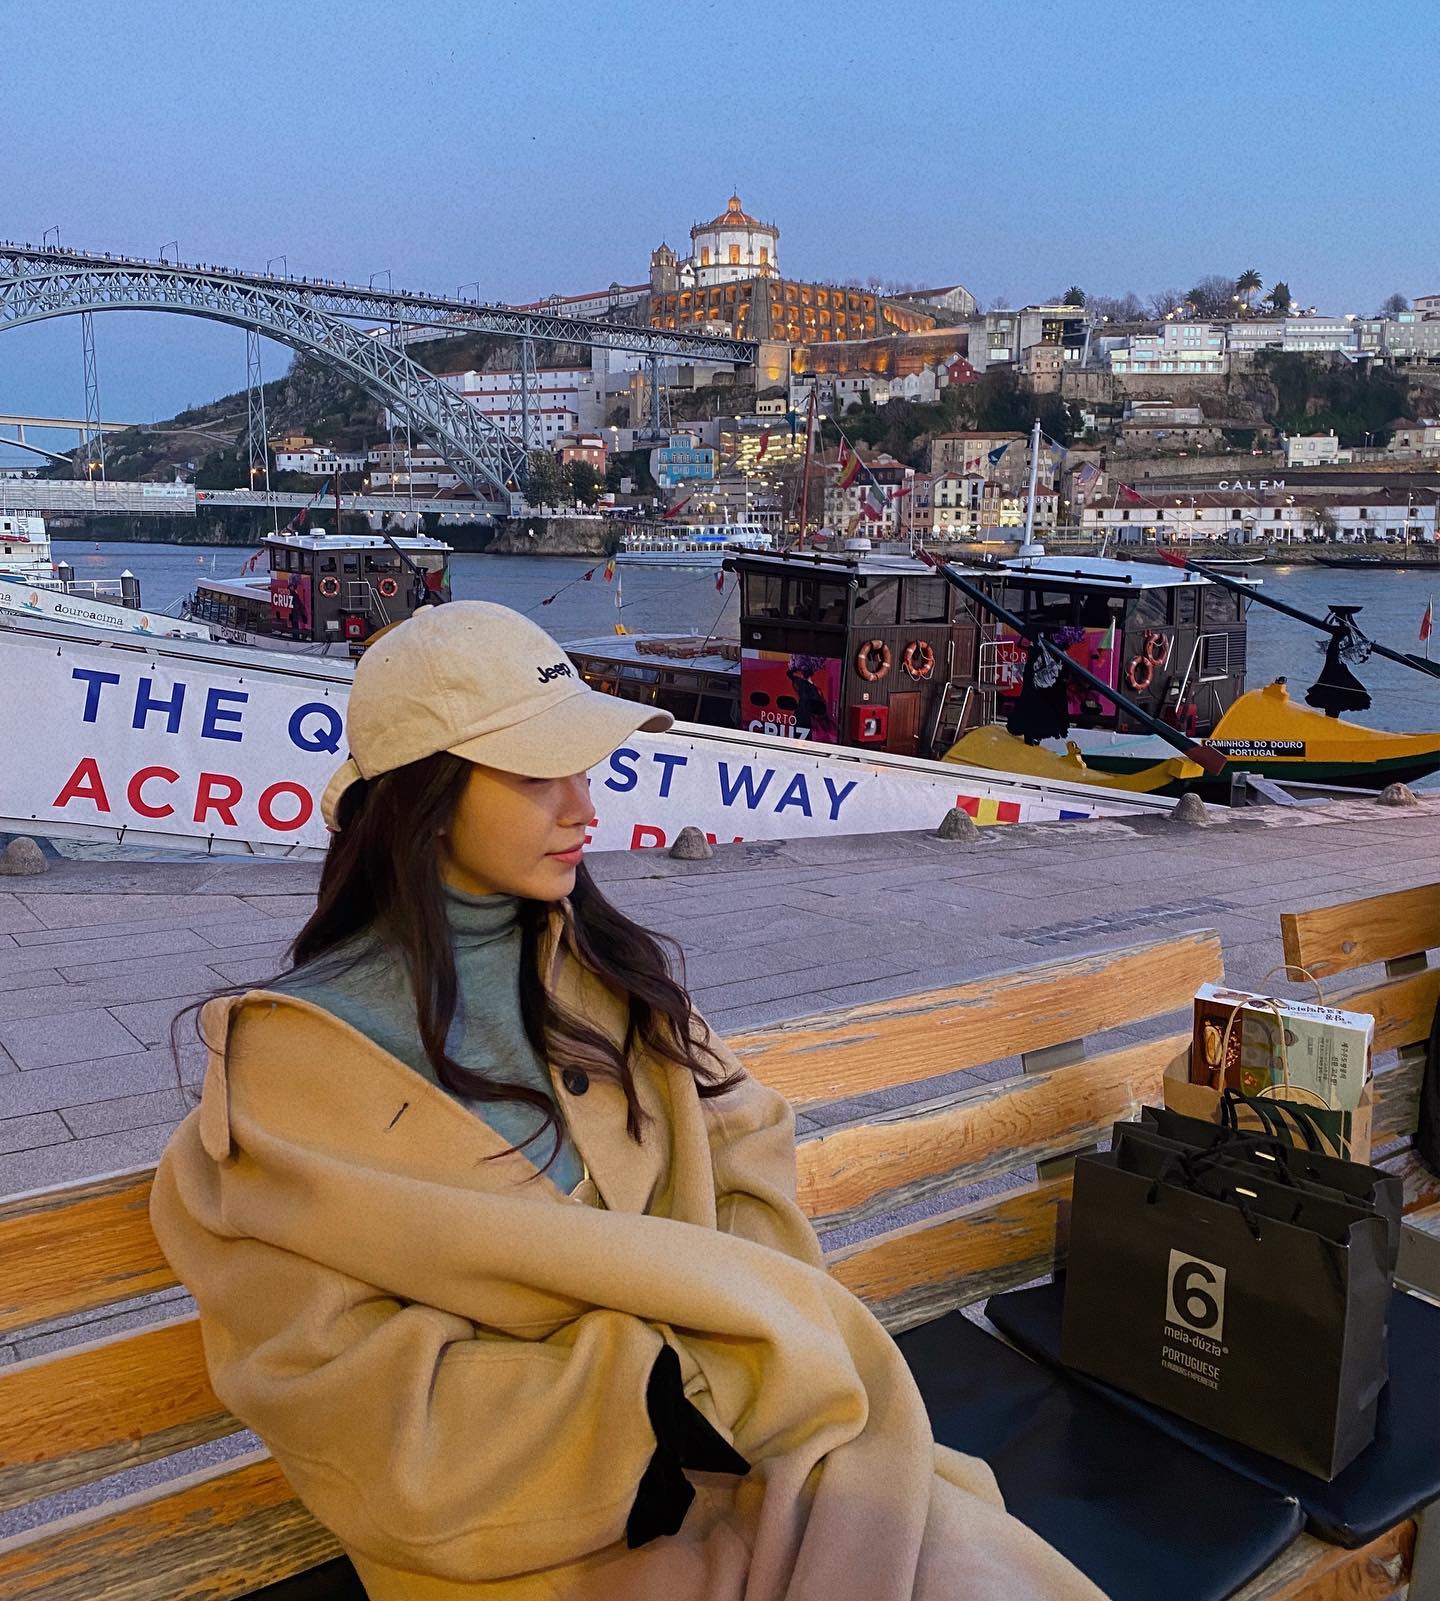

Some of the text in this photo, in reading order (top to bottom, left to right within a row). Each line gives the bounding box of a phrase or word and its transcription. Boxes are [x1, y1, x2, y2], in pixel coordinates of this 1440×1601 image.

[273, 593, 294, 608] CRUZ
[55, 603, 123, 625] douroacima
[1003, 650, 1027, 662] POR
[537, 663, 571, 683] Jeep
[72, 668, 249, 742] THE
[761, 710, 797, 726] PORTO
[1205, 740, 1303, 749] CAMINHOS DO DOURO
[1230, 748, 1277, 757] PORTUGAL
[52, 757, 314, 832] ACRO
[718, 761, 858, 821] WAY
[1172, 1261, 1219, 1330] 6
[1162, 1346, 1220, 1380] PORTUGUESE
